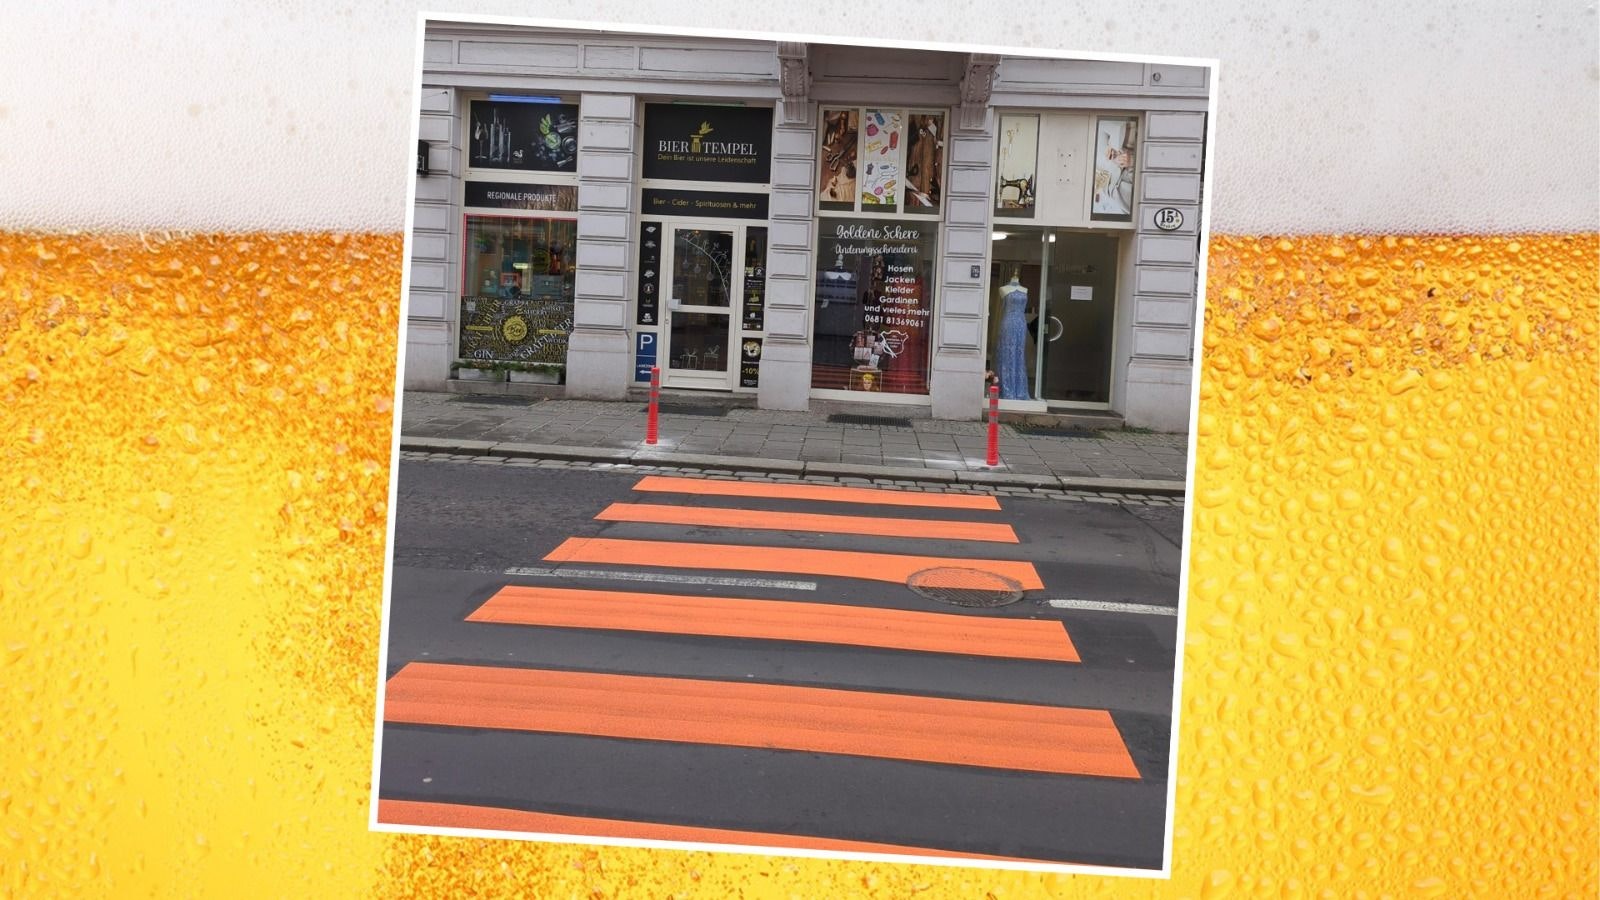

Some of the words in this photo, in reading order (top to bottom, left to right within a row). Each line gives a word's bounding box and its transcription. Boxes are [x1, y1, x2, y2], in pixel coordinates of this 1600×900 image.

[658, 140, 689, 153] BIER
[703, 142, 757, 156] TEMPEL
[718, 156, 757, 165] Leidenschaft
[487, 191, 522, 201] REGIONALE
[524, 193, 557, 203] PRODUKTE
[653, 197, 666, 205] Bier
[672, 198, 689, 206] Cider
[695, 199, 732, 209] Spirituosen
[836, 224, 882, 240] Goldene
[883, 225, 920, 240] Schere
[887, 264, 914, 273] Hosen
[884, 275, 916, 284] Jacken
[879, 295, 919, 305] Gardinen
[864, 305, 880, 313] und
[882, 306, 906, 315] vieles
[908, 308, 930, 316] mehr
[864, 314, 884, 324] 0681
[886, 316, 924, 327] 81369061
[640, 334, 654, 350] P
[474, 349, 494, 359] GIN
